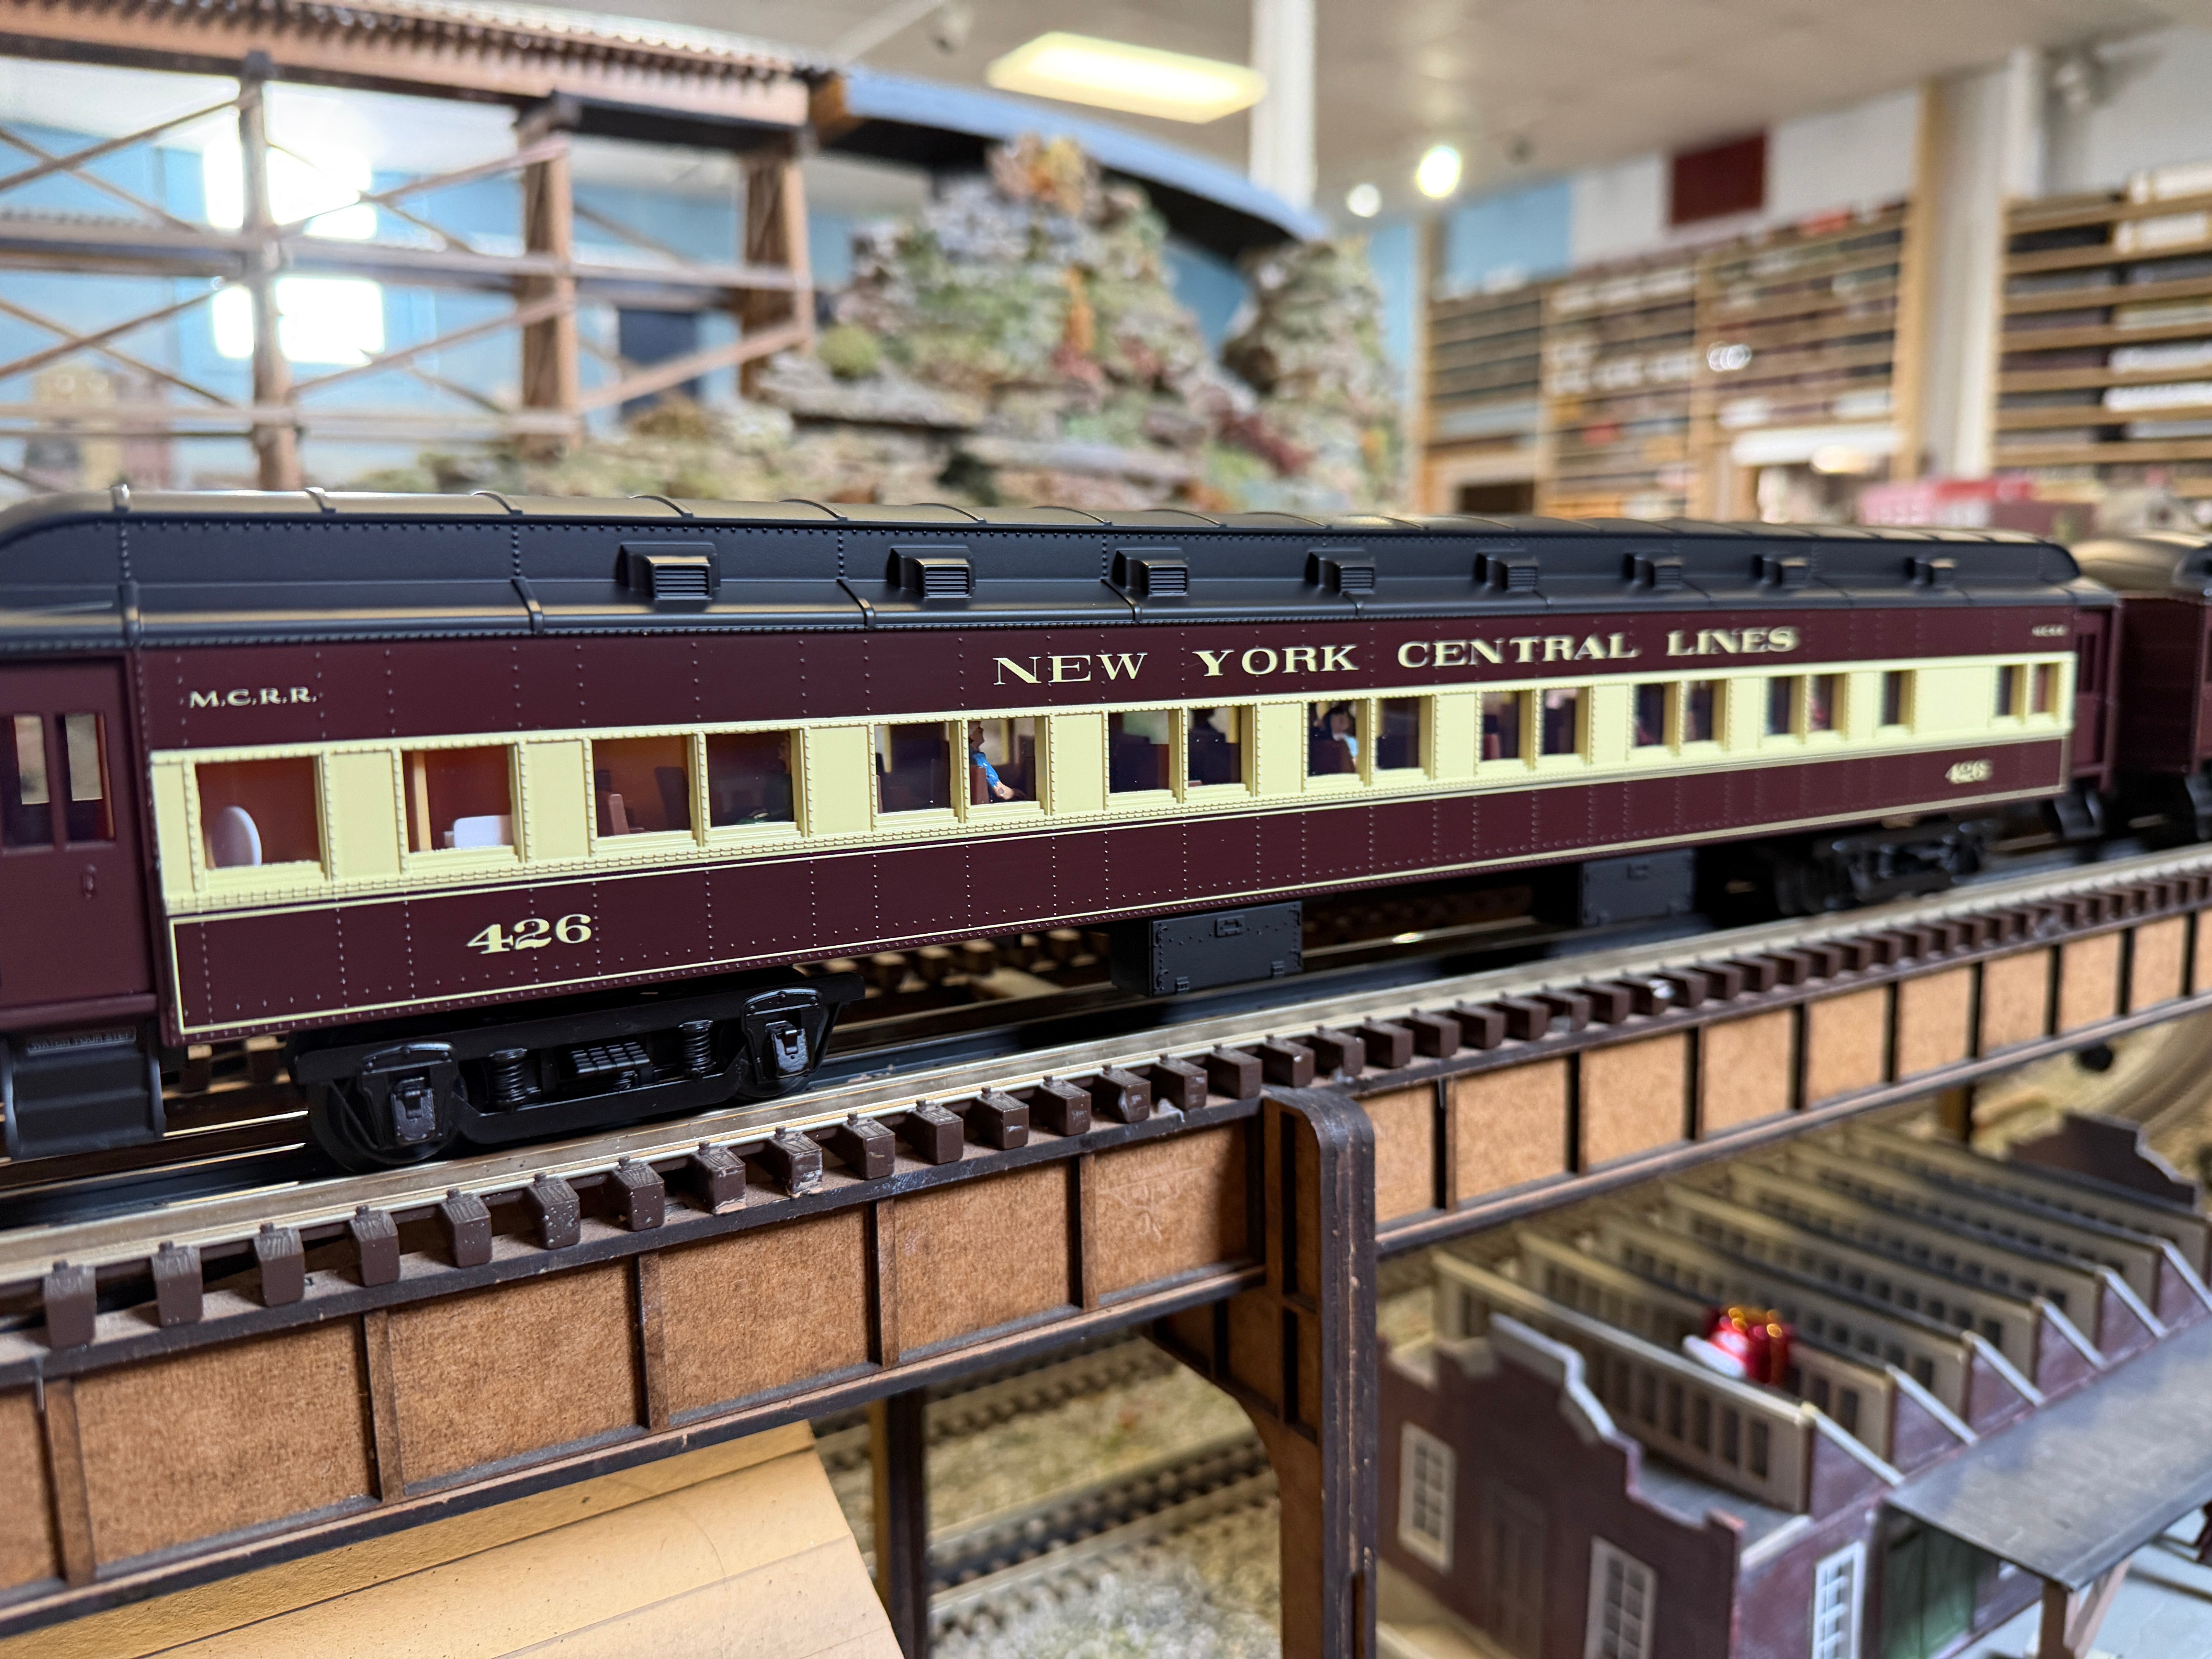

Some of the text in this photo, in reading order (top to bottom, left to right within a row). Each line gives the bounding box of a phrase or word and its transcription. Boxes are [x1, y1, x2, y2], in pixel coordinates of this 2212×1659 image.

[993, 625, 1799, 685] NEW YORK CENTRAL LINES
[189, 686, 318, 709] M.C.R.R.
[465, 913, 592, 955] 426
